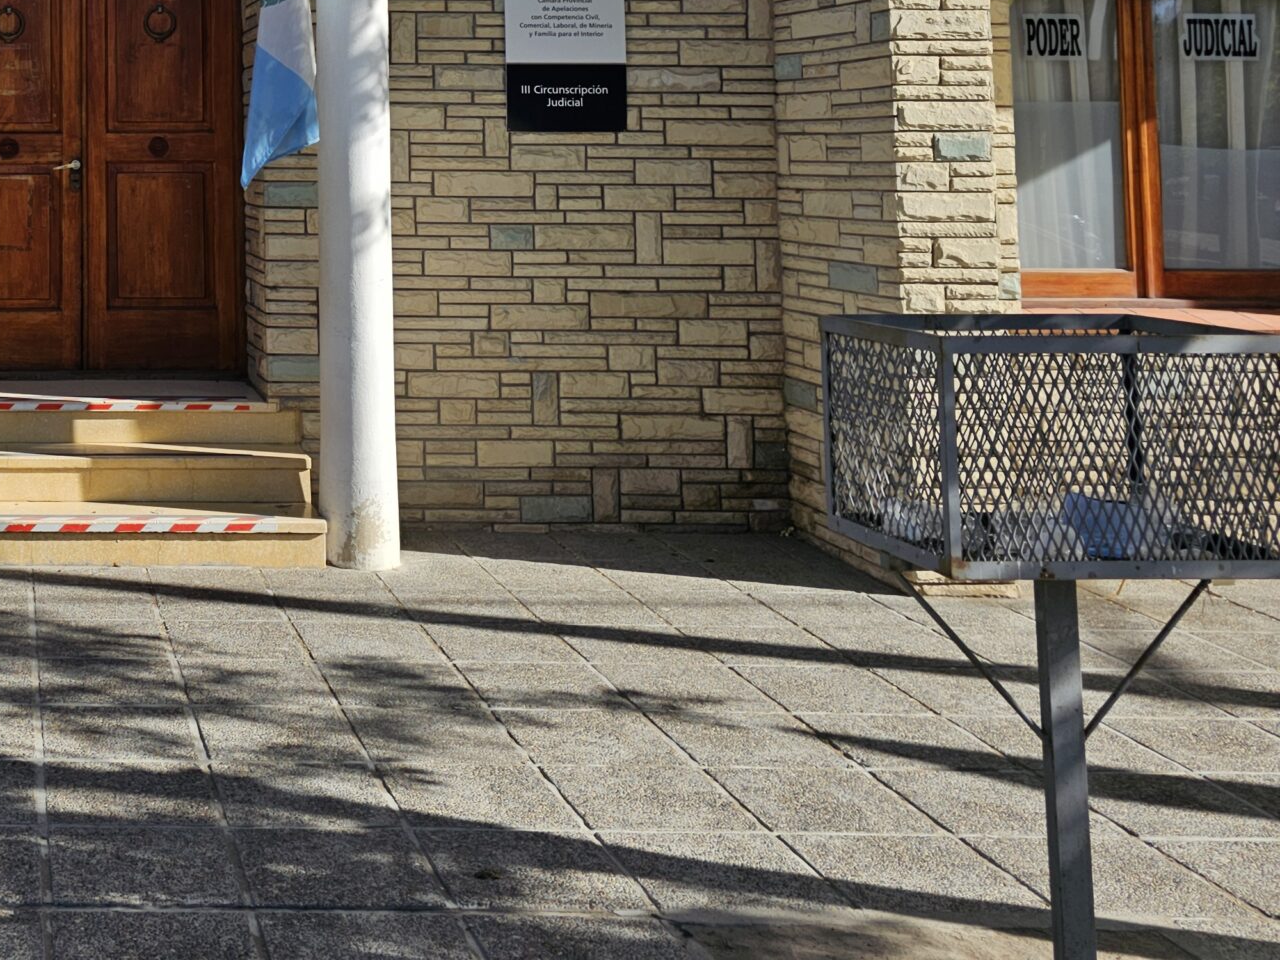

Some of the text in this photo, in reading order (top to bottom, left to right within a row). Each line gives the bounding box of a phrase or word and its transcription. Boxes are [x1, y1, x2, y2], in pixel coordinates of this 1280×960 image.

[543, 14, 584, 22] Competencia
[1025, 18, 1258, 58] PODER JUDICIAL
[521, 84, 609, 96] III Circunscripción
[546, 97, 584, 107] Judicial
